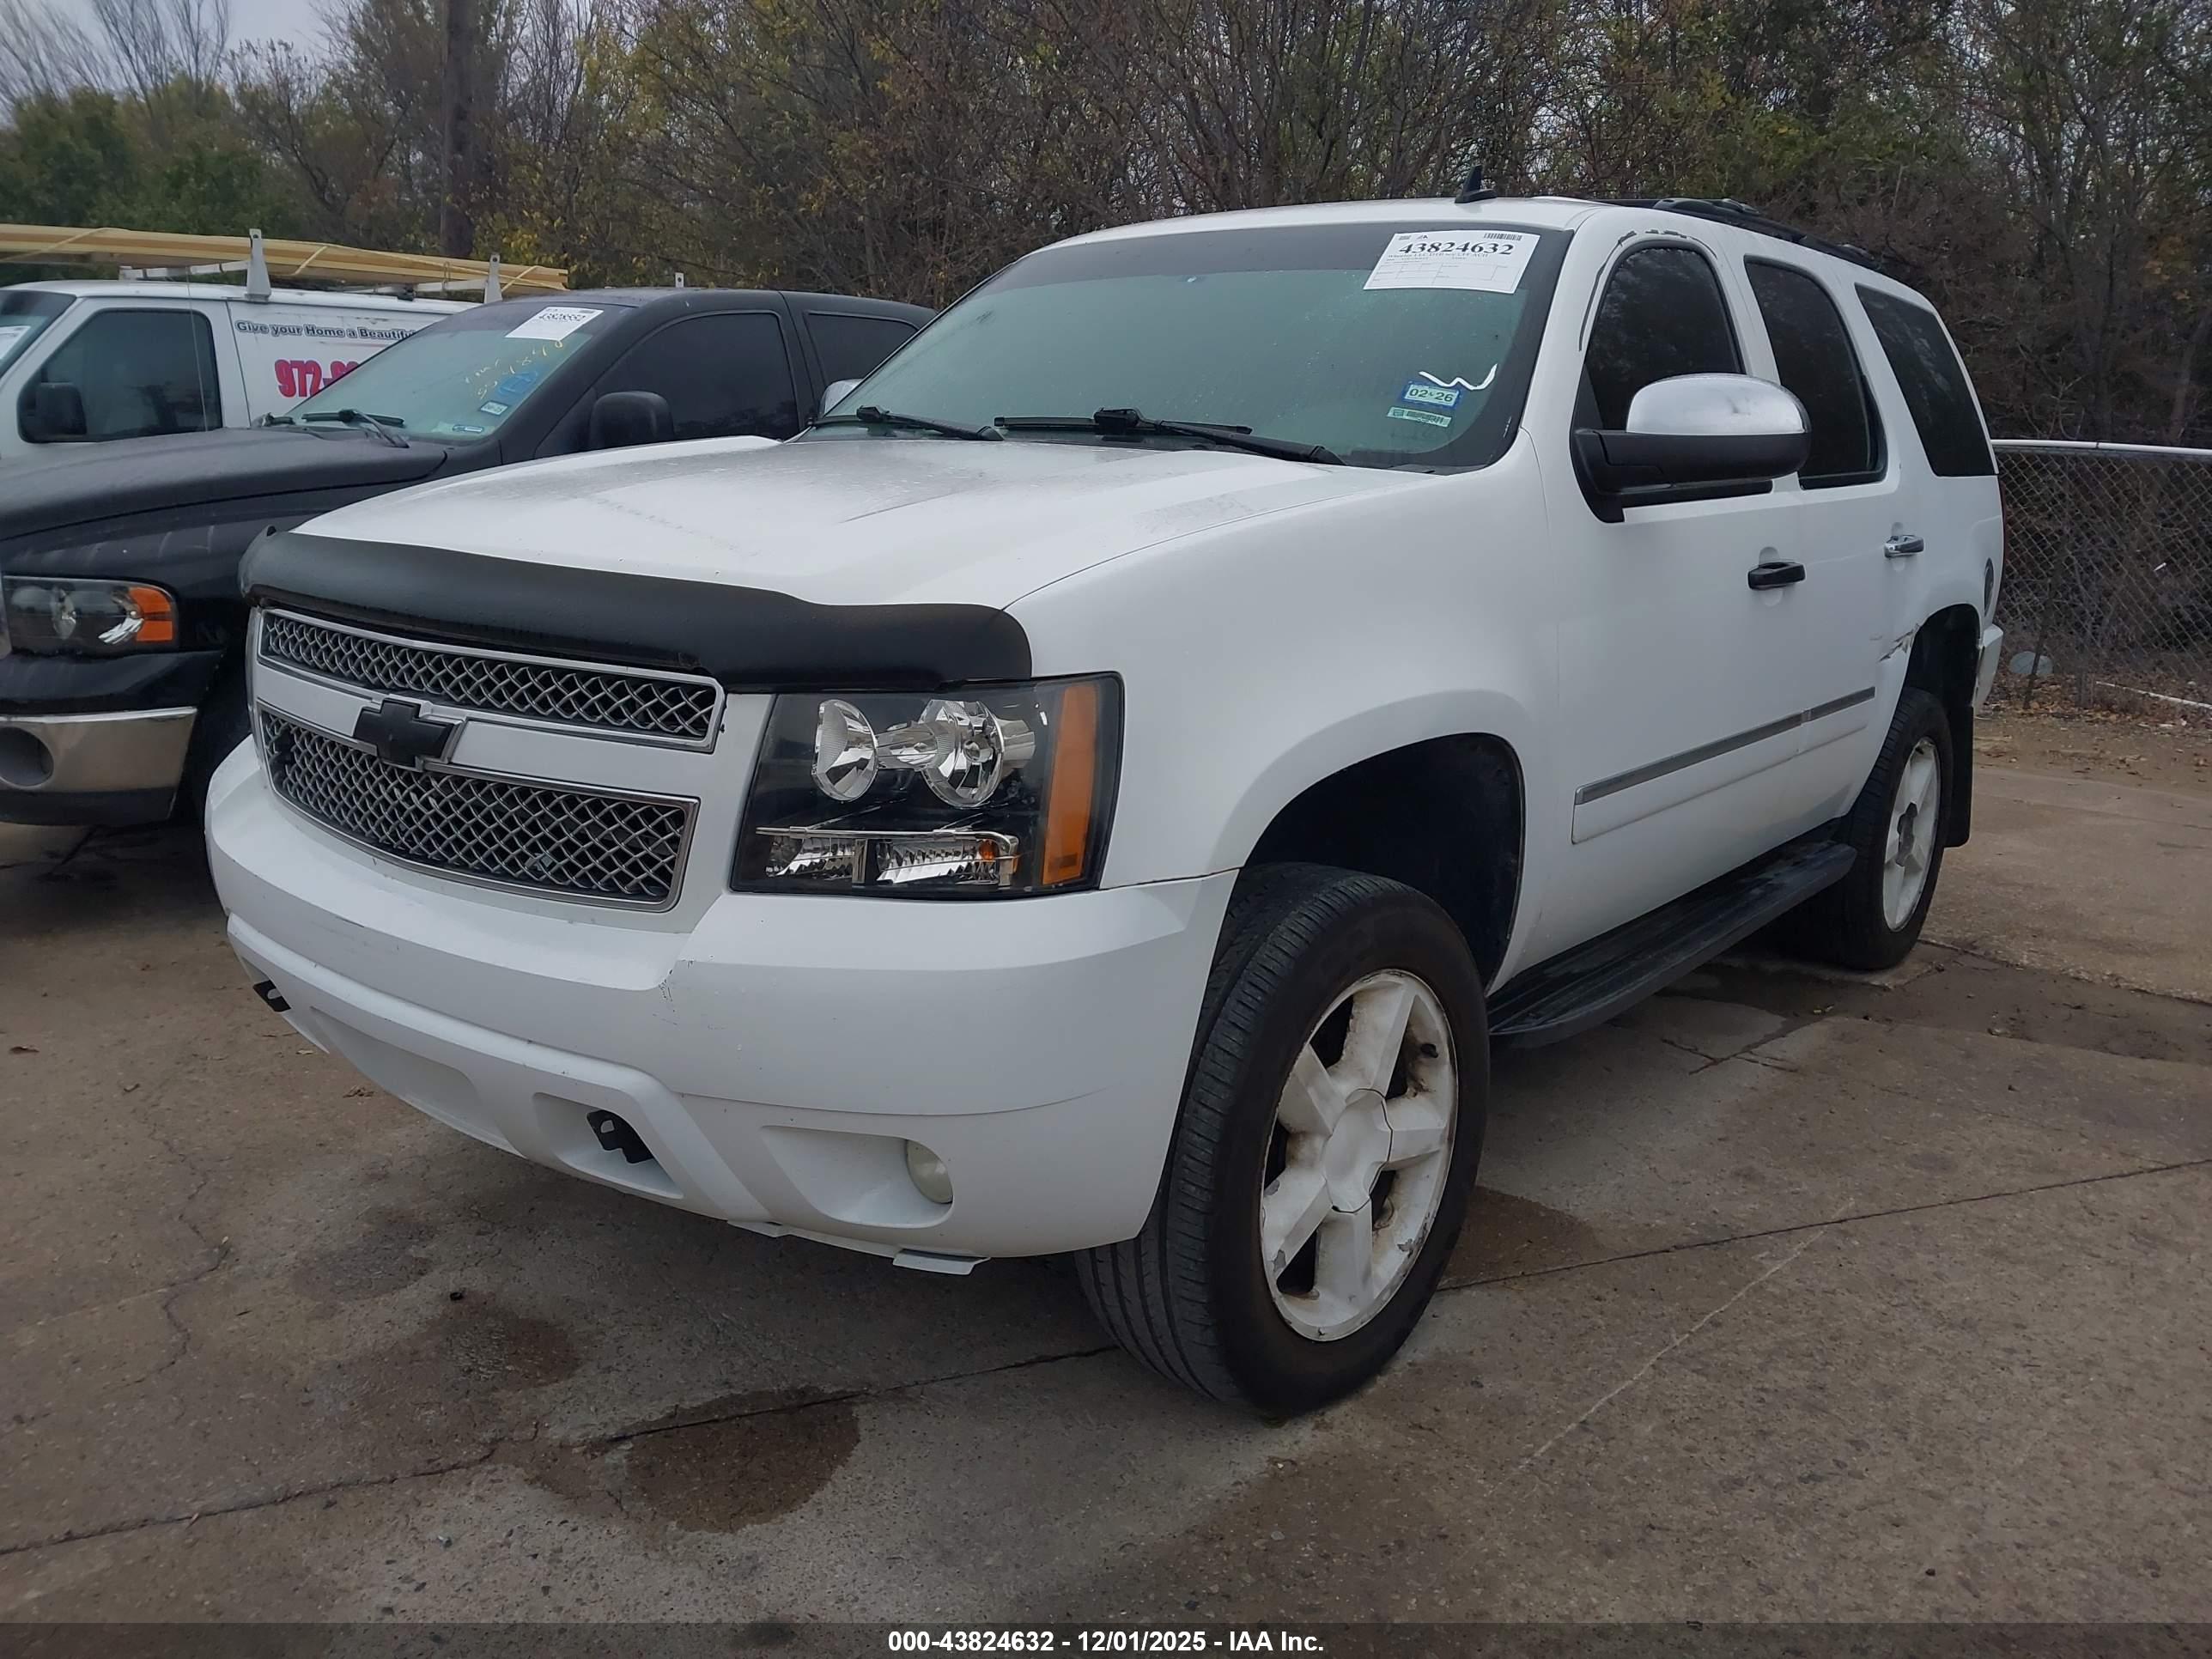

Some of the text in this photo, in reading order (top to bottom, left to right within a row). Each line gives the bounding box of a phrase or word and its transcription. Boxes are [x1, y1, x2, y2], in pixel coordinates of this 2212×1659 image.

[1399, 241, 1514, 255] 43824632
[235, 320, 269, 334] Give
[271, 324, 301, 337] your
[305, 324, 344, 337] Home
[347, 328, 358, 339] a
[1409, 388, 1454, 403] 02 26
